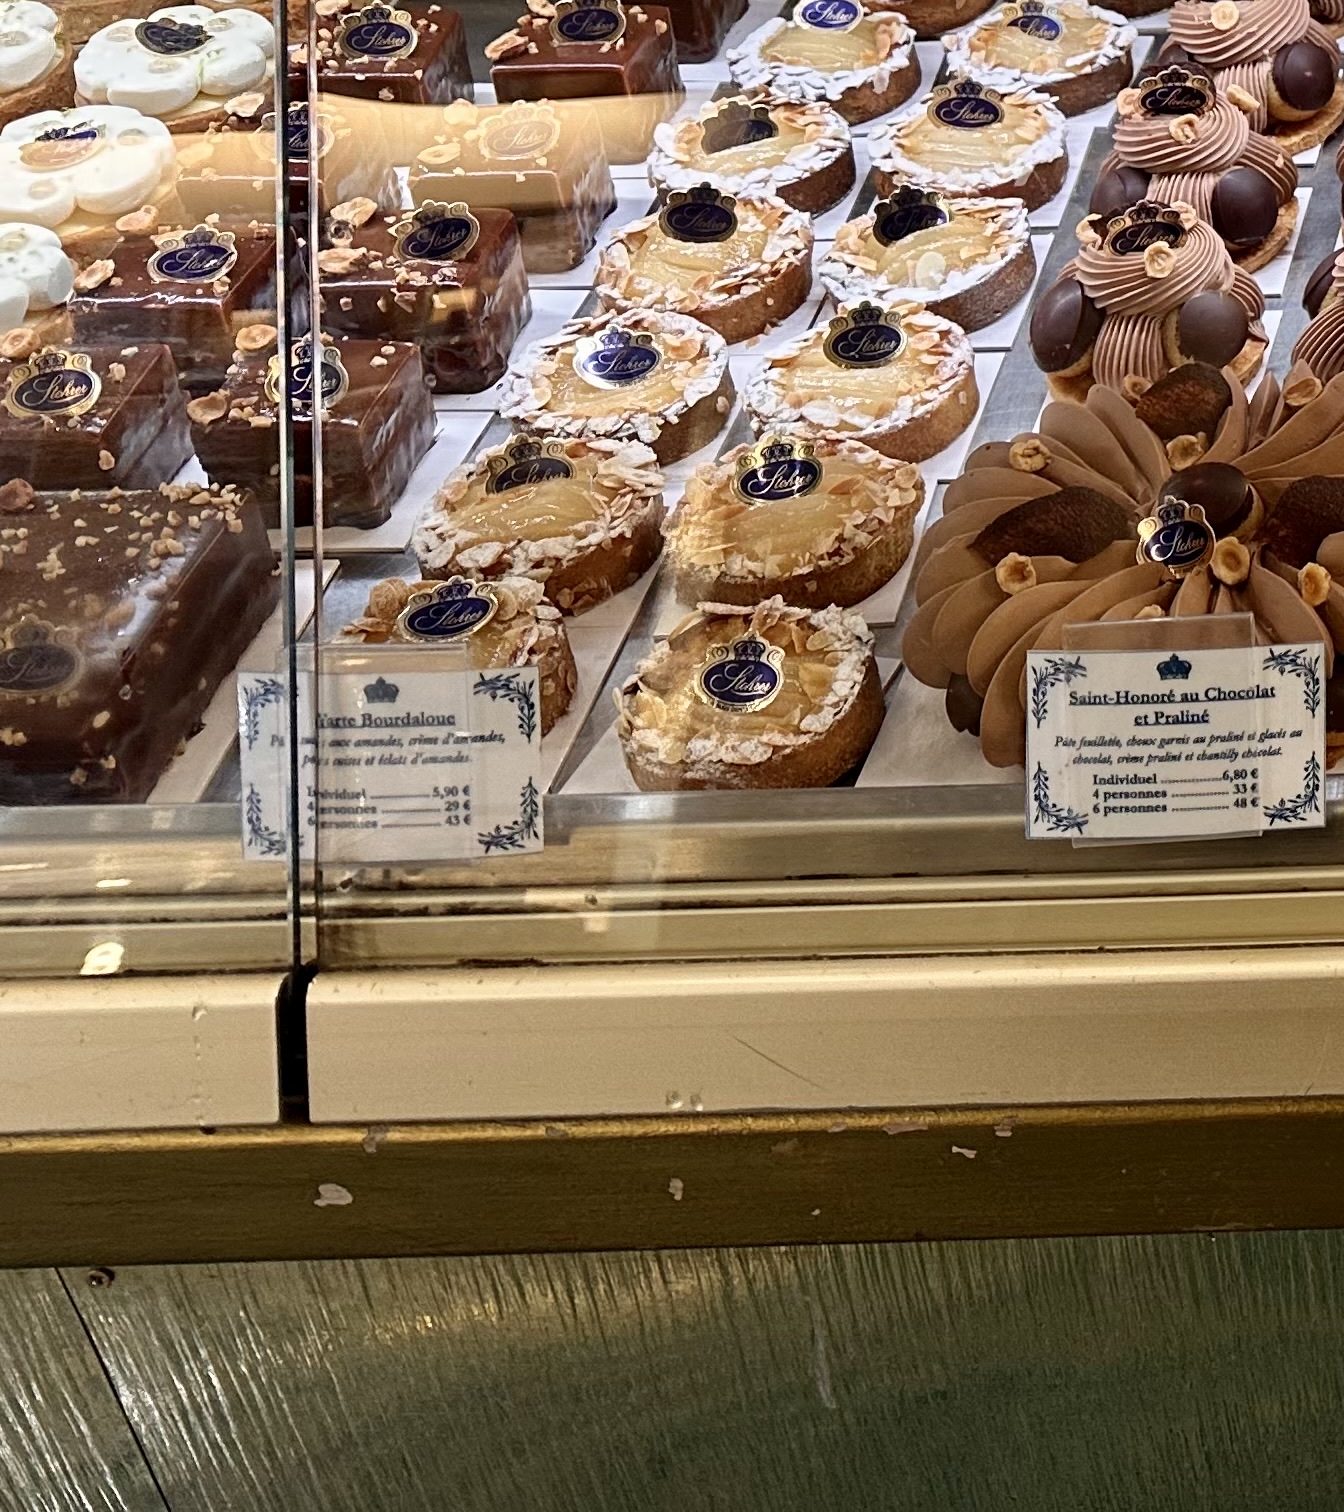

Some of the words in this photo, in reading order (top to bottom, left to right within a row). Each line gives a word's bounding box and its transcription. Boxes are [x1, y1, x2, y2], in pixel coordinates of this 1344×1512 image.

[22, 375, 88, 406] Stohrer
[710, 664, 770, 696] Stohrer
[1069, 689, 1175, 705] Saint-Honoré
[1181, 692, 1199, 703] au
[1204, 685, 1275, 701] Chocolat
[361, 713, 456, 727] Bourdaloue
[1134, 714, 1149, 726] et
[1154, 709, 1209, 724] Praliné
[1055, 735, 1076, 747] Pâte
[1093, 774, 1157, 785] Individuel
[1251, 769, 1259, 779] €
[432, 786, 459, 799] 5,90
[463, 785, 470, 797] €
[1093, 789, 1100, 799] 4
[1103, 790, 1168, 802] personnes
[1250, 783, 1259, 794] €
[445, 801, 460, 812] 29
[463, 800, 470, 811] €
[1093, 803, 1100, 814] 6
[1103, 804, 1168, 817] personnes
[1250, 797, 1260, 808] €
[445, 815, 460, 826] 43
[463, 814, 471, 825] €
